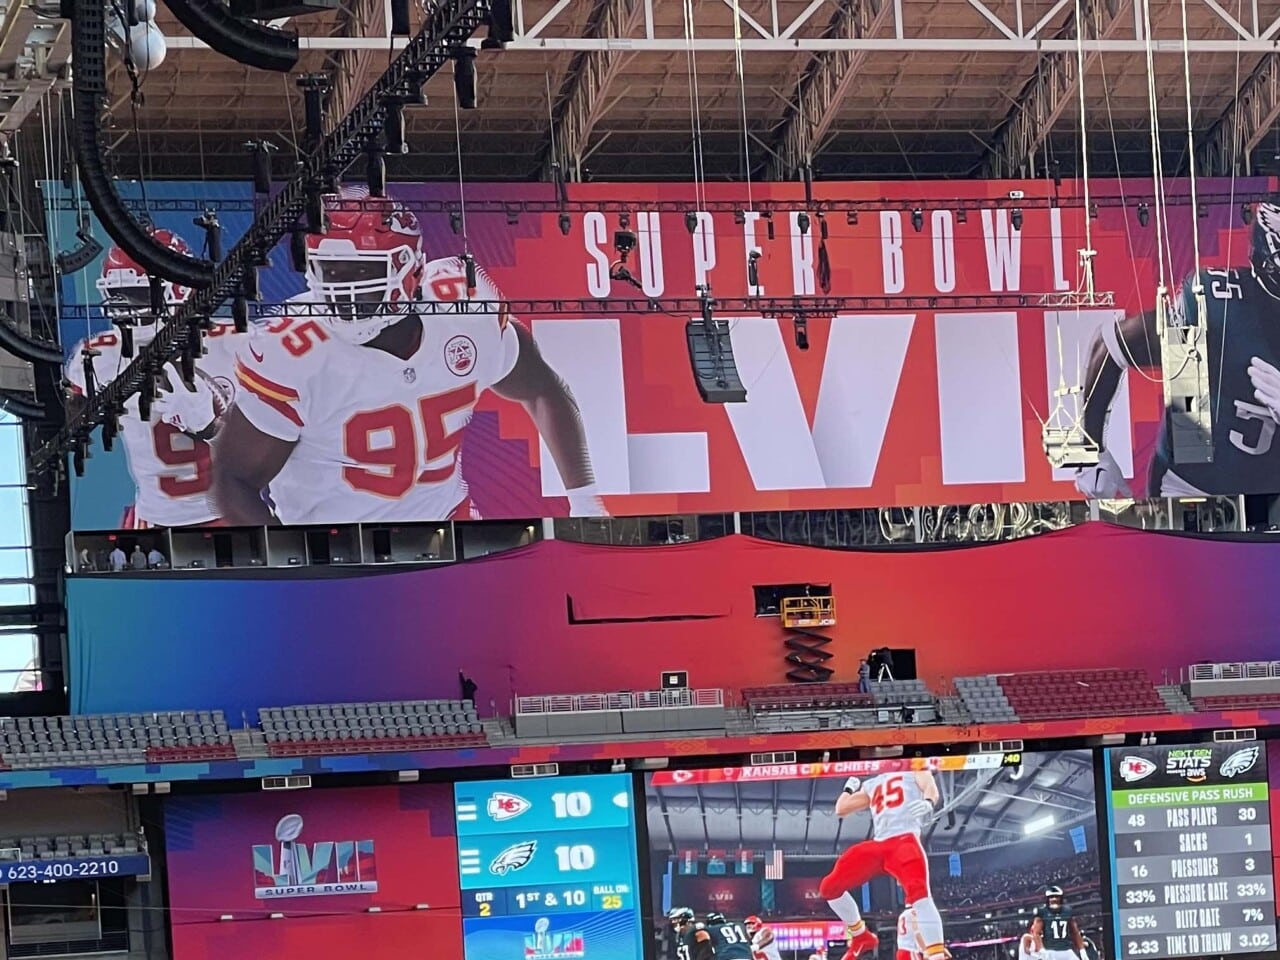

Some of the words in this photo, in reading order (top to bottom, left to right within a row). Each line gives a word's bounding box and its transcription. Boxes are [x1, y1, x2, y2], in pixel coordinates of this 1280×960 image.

[583, 211, 816, 298] SUPER
[880, 208, 1070, 294] BOWL
[540, 308, 1134, 496] LVII
[342, 381, 479, 499] 95
[1166, 756, 1212, 769] STATS
[1168, 749, 1193, 758] NEXT
[742, 764, 798, 777] KANSAS
[801, 763, 831, 775] CITY
[834, 760, 880, 772] CHIEFS
[1187, 768, 1206, 777] aws
[551, 791, 592, 818] 10
[869, 775, 905, 816] 45
[1128, 791, 1190, 806] DEFENSIVE
[1192, 789, 1221, 802] PASS
[1223, 787, 1254, 800] RUSH
[1127, 814, 1146, 828] 48
[1166, 808, 1190, 828] PASS
[1191, 806, 1218, 827] PLAYS
[1238, 807, 1257, 821] 30
[1133, 839, 1142, 853] 1
[1179, 832, 1208, 853] SACKS
[1244, 833, 1253, 846] 1
[252, 839, 378, 888] LVII
[554, 844, 595, 871] 10
[8, 860, 119, 880] 623-400-2210
[1131, 864, 1149, 878] 16
[1171, 857, 1219, 879] PRESSURES
[1244, 858, 1255, 872] 3
[265, 885, 315, 896] SUPER
[323, 884, 368, 893] BOWL
[475, 892, 493, 903] QTR
[544, 892, 558, 906] &
[563, 890, 586, 906] 10
[593, 885, 614, 895] BALL
[1125, 890, 1156, 904] 33%
[1164, 882, 1206, 904] PRESSURE
[1207, 881, 1229, 902] RATE
[1236, 882, 1266, 897] 33%
[479, 904, 491, 917] 2
[602, 895, 622, 909] 25
[1127, 915, 1158, 930] 35%
[1175, 908, 1199, 929] BLITZ
[1199, 907, 1221, 927] RATE
[1242, 908, 1265, 922] 7%
[720, 925, 748, 944] 91
[1050, 920, 1068, 939] 17
[1128, 939, 1160, 955] 2.33
[1166, 935, 1187, 955] TIME
[1188, 933, 1200, 954] TO
[1200, 931, 1232, 953] THROW
[1239, 932, 1270, 947] 3.02
